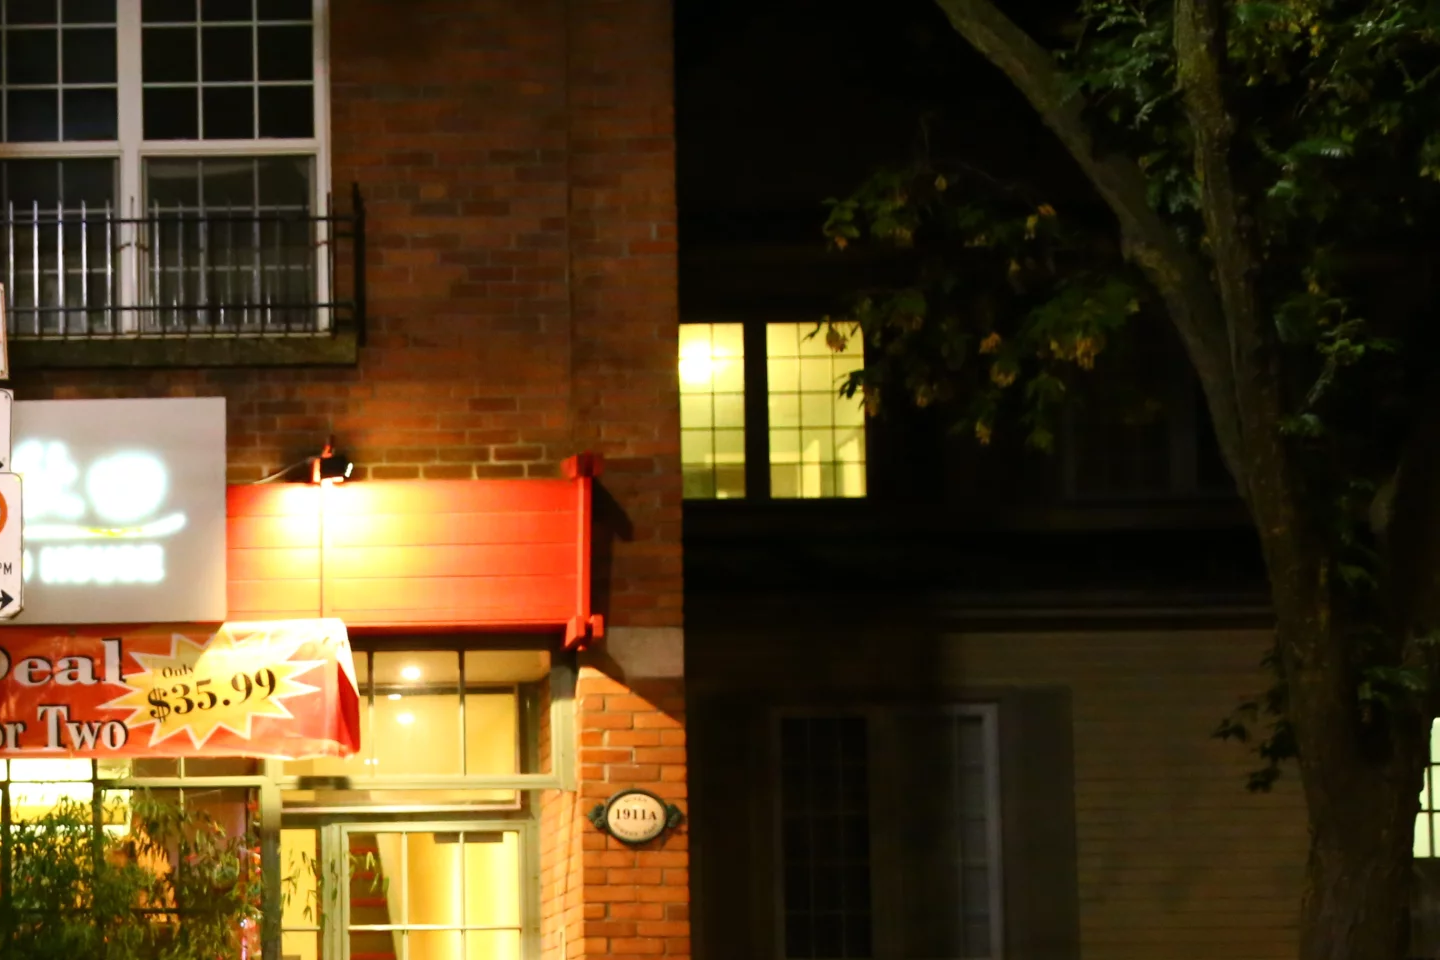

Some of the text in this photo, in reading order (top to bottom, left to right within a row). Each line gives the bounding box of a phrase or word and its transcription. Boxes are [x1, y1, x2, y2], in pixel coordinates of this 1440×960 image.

[162, 663, 194, 680] Only
[147, 667, 276, 723] $35.99
[37, 703, 129, 751] Two
[616, 808, 657, 821] 1911A
